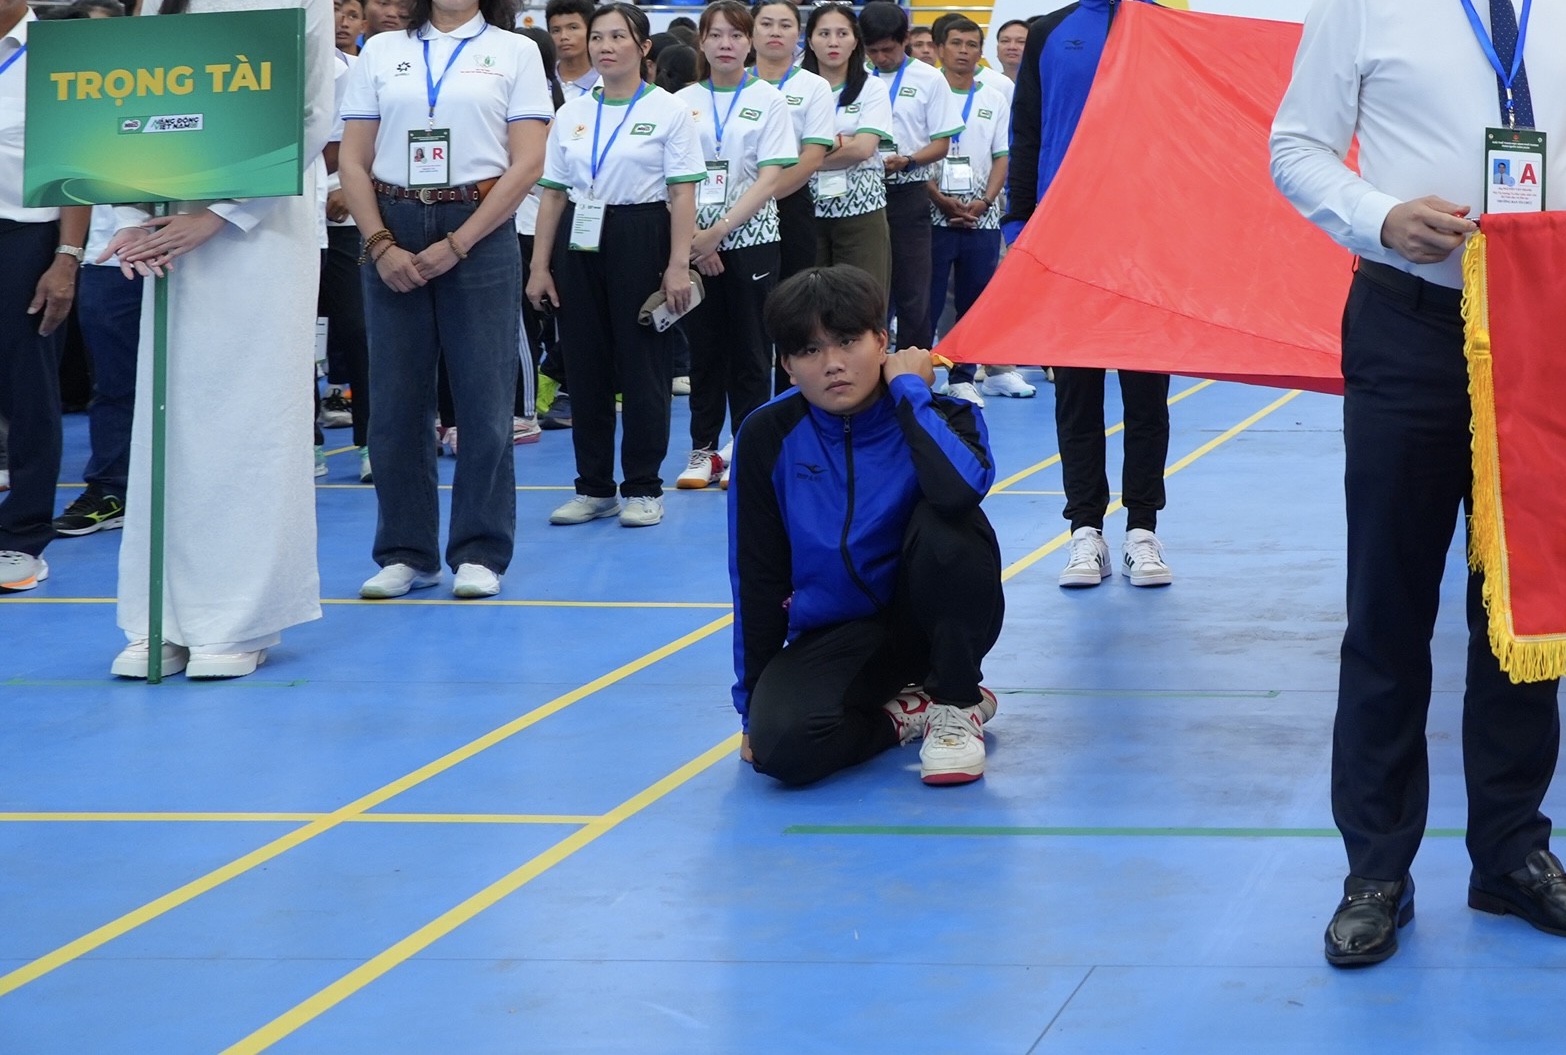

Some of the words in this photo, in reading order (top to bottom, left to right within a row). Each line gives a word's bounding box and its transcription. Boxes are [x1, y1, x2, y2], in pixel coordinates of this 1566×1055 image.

[51, 65, 194, 107] TRỌNG
[205, 54, 272, 93] TÀI
[432, 147, 444, 160] R
[715, 174, 724, 185] R
[1519, 163, 1537, 185] A
